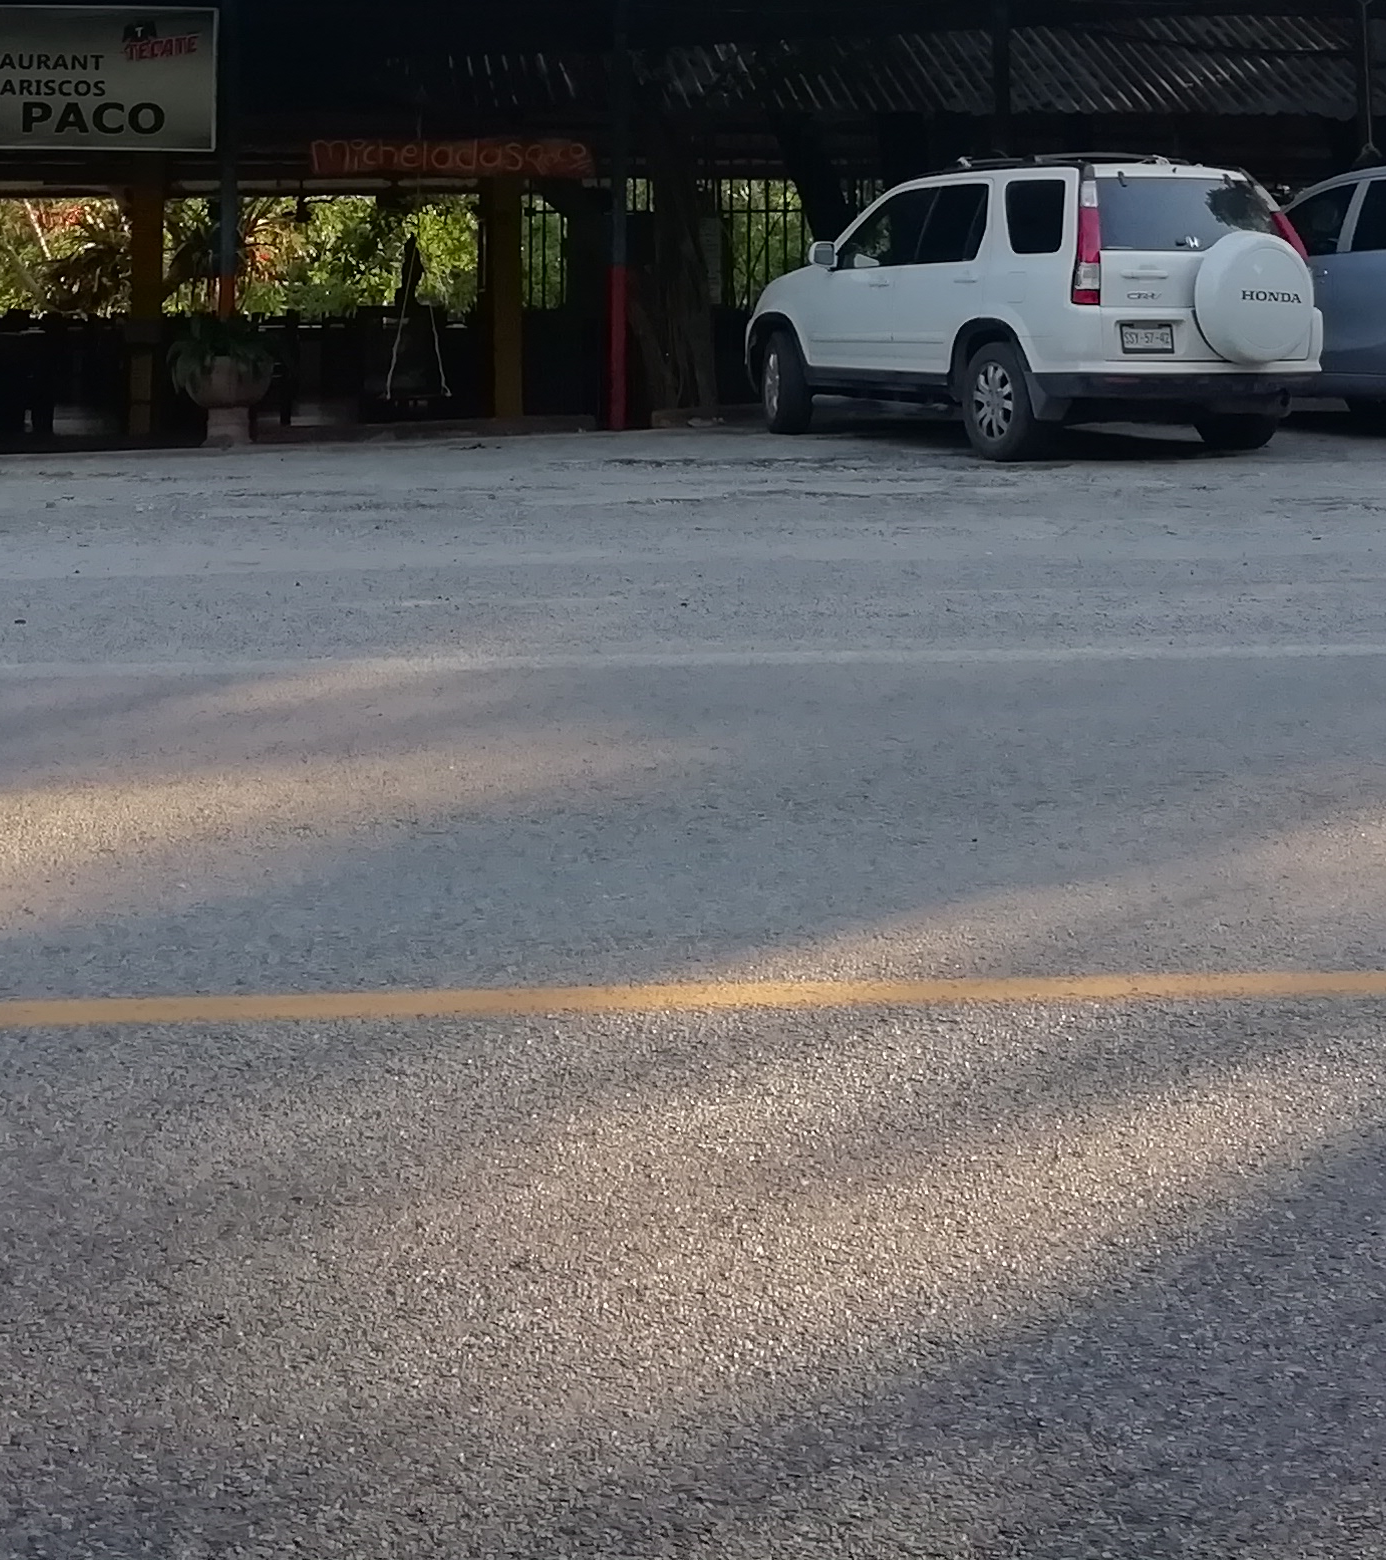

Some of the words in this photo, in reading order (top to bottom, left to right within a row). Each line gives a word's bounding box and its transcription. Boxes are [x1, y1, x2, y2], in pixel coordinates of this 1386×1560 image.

[126, 35, 199, 61] TECATE
[21, 101, 165, 134] PACO
[313, 139, 523, 173] Micheladas
[1241, 290, 1302, 303] HONDA
